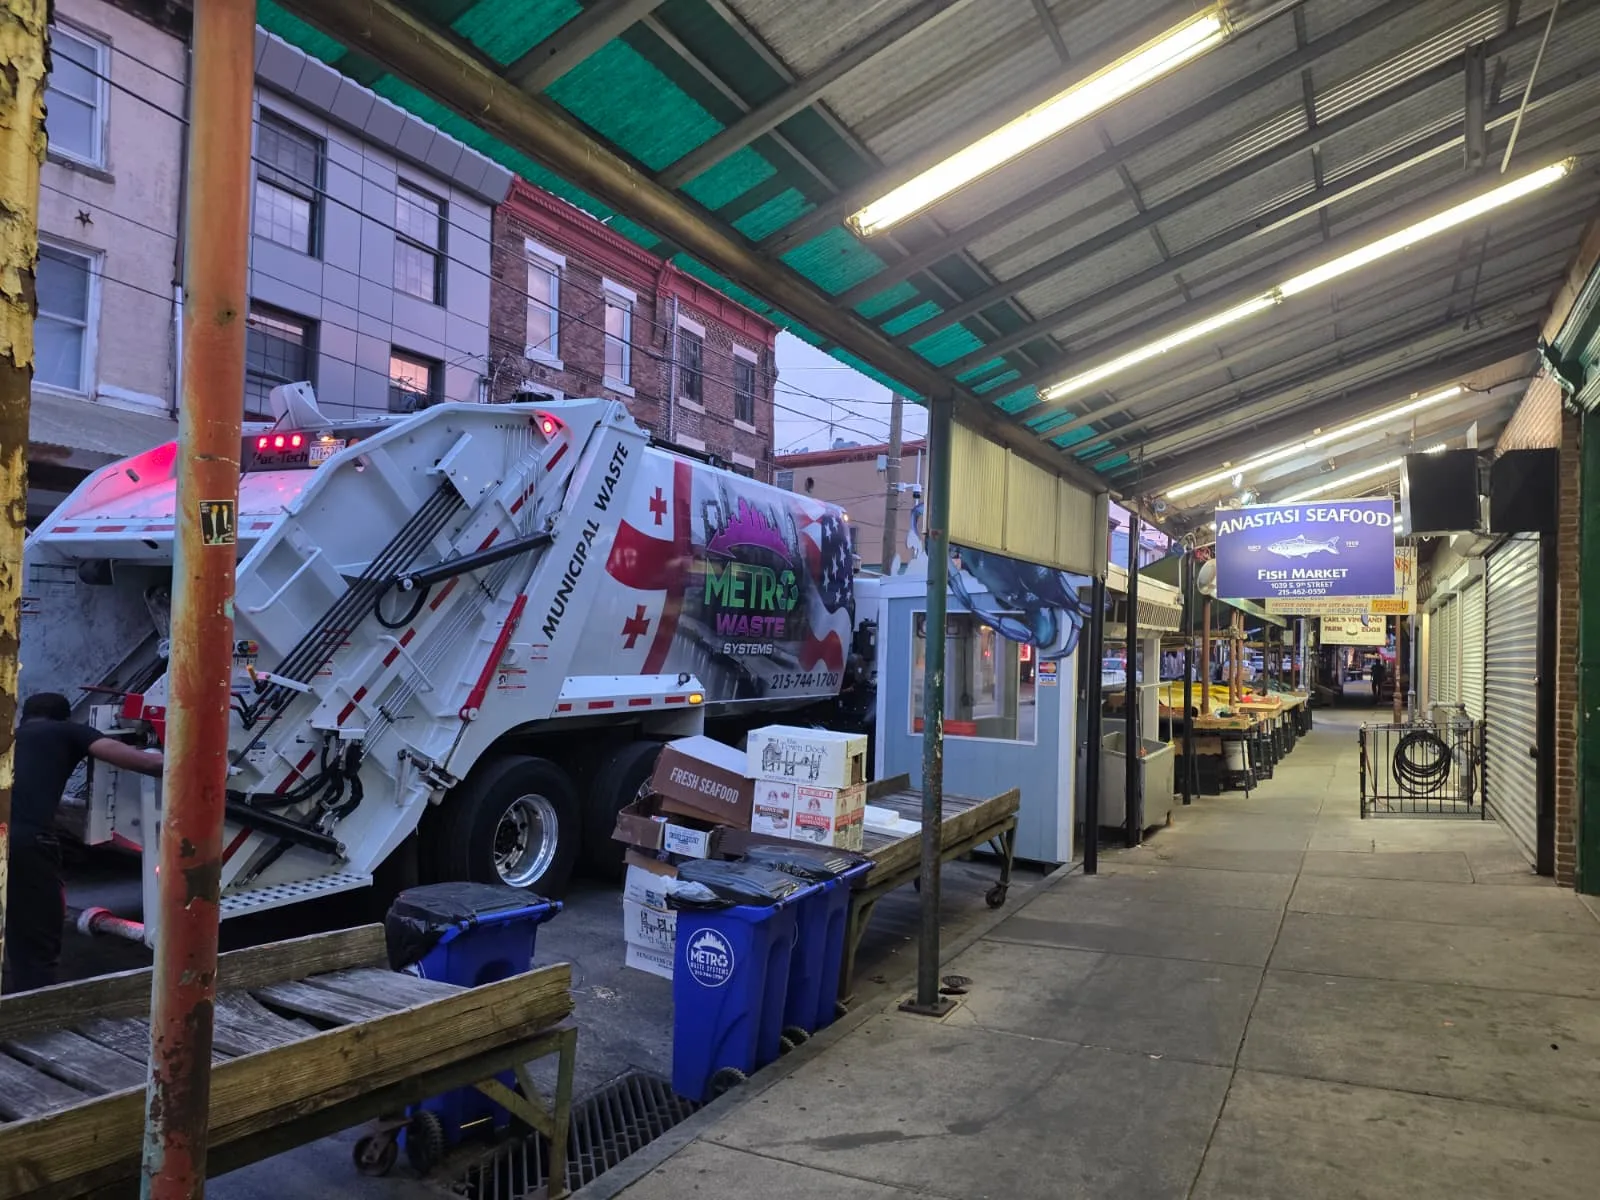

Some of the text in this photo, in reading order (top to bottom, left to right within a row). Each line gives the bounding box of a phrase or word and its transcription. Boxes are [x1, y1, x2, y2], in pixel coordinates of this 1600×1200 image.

[1217, 508, 1392, 536] ANASTASI SEAFOOD
[542, 441, 629, 641] MUNICIPAL WASTE
[716, 613, 786, 637] WASTE
[723, 642, 773, 654] SYSTEMS
[769, 673, 839, 689] 215-744-1700
[669, 767, 739, 804] FRESH SEAFOOD
